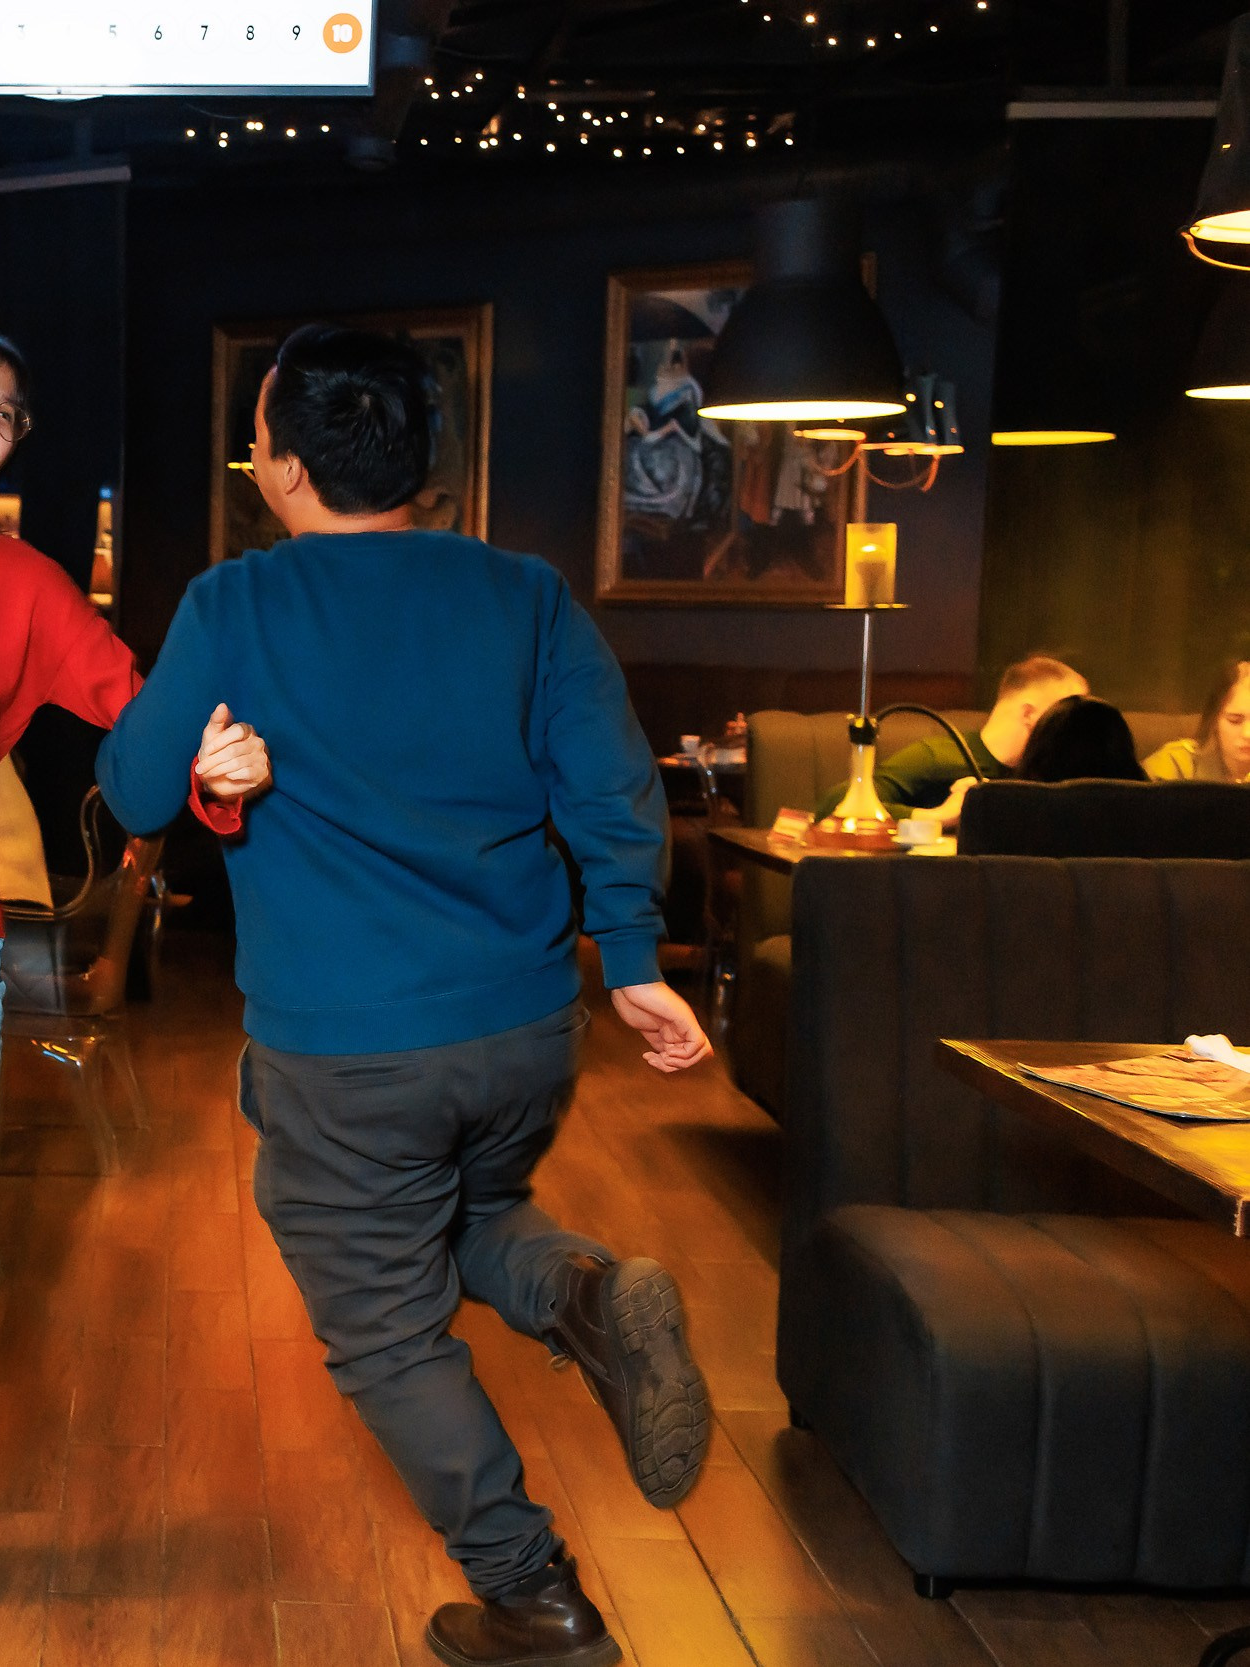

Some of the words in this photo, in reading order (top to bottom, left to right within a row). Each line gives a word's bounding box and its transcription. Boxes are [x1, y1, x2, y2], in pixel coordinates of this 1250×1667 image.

[108, 24, 118, 39] 5
[153, 24, 163, 41] 6
[200, 24, 209, 41] 7
[245, 24, 255, 41] 8
[291, 24, 302, 41] 9
[331, 24, 353, 43] 10
